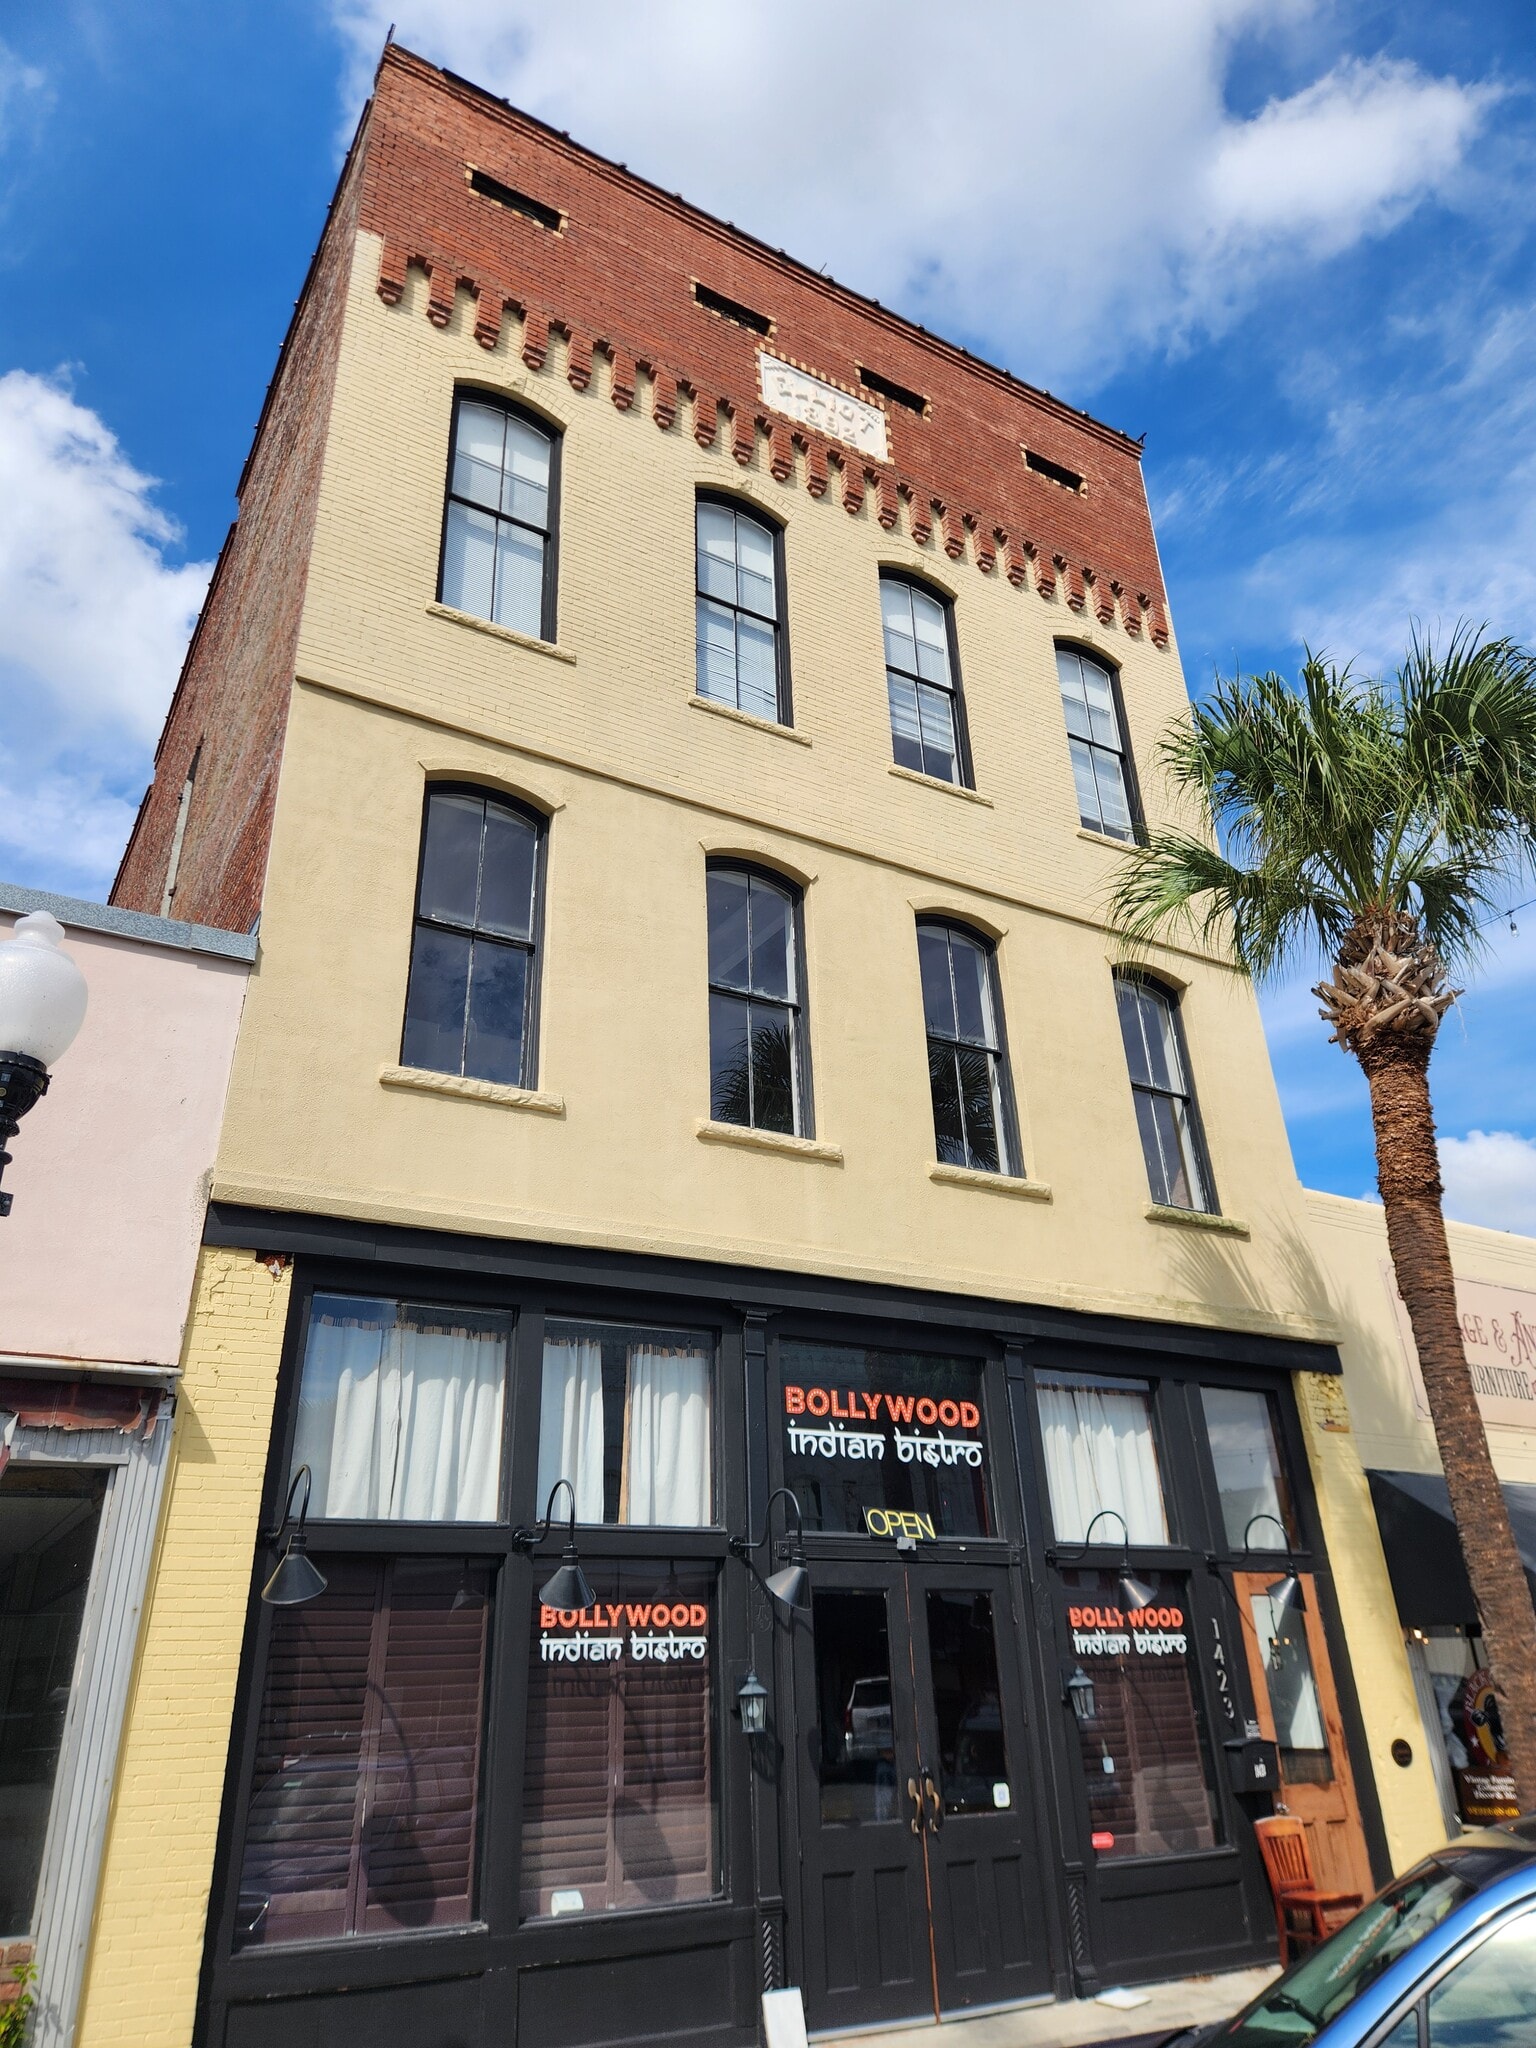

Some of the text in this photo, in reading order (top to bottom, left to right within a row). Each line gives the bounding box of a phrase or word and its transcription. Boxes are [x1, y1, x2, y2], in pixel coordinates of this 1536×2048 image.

[1491, 1318, 1508, 1354] &
[1467, 1363, 1534, 1401] URNITURE
[784, 1385, 982, 1429] BOLLYWOOD
[786, 1418, 984, 1468] indian bistro
[867, 1508, 937, 1540] OPEN
[539, 1603, 708, 1629] BOLLYWOOD
[1069, 1606, 1184, 1628] BOLLYWOOD
[539, 1629, 708, 1663] indian bistro
[1072, 1628, 1188, 1657] indian bistro
[1211, 1617, 1235, 1719] 1423
